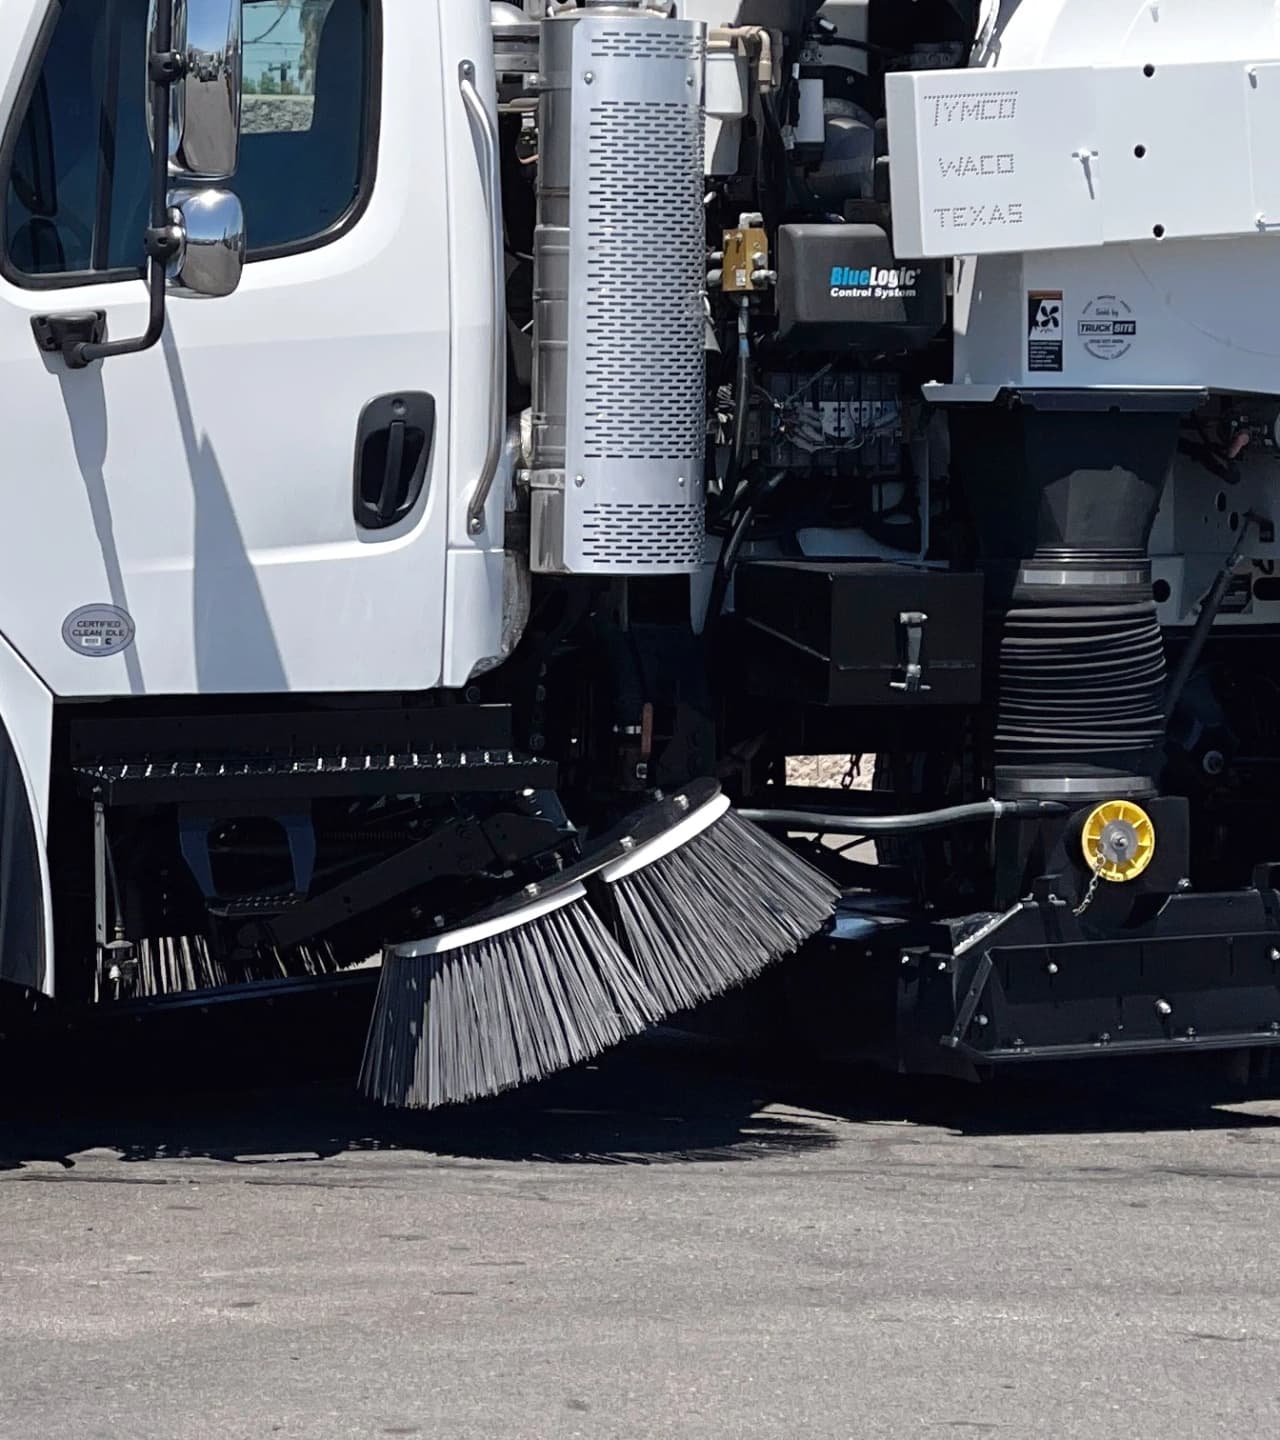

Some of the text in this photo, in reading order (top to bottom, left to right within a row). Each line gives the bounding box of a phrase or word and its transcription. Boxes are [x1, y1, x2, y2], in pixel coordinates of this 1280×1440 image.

[923, 90, 1019, 127] TYMCO
[938, 153, 1015, 177] WACO
[933, 203, 1023, 228] TEXAS
[830, 266, 916, 289] BlueLogic
[830, 287, 916, 300] Control System
[1080, 323, 1135, 333] TRUCK SITE
[72, 629, 125, 637] CLEAN IDLE
[76, 620, 121, 628] CERTIFIED
